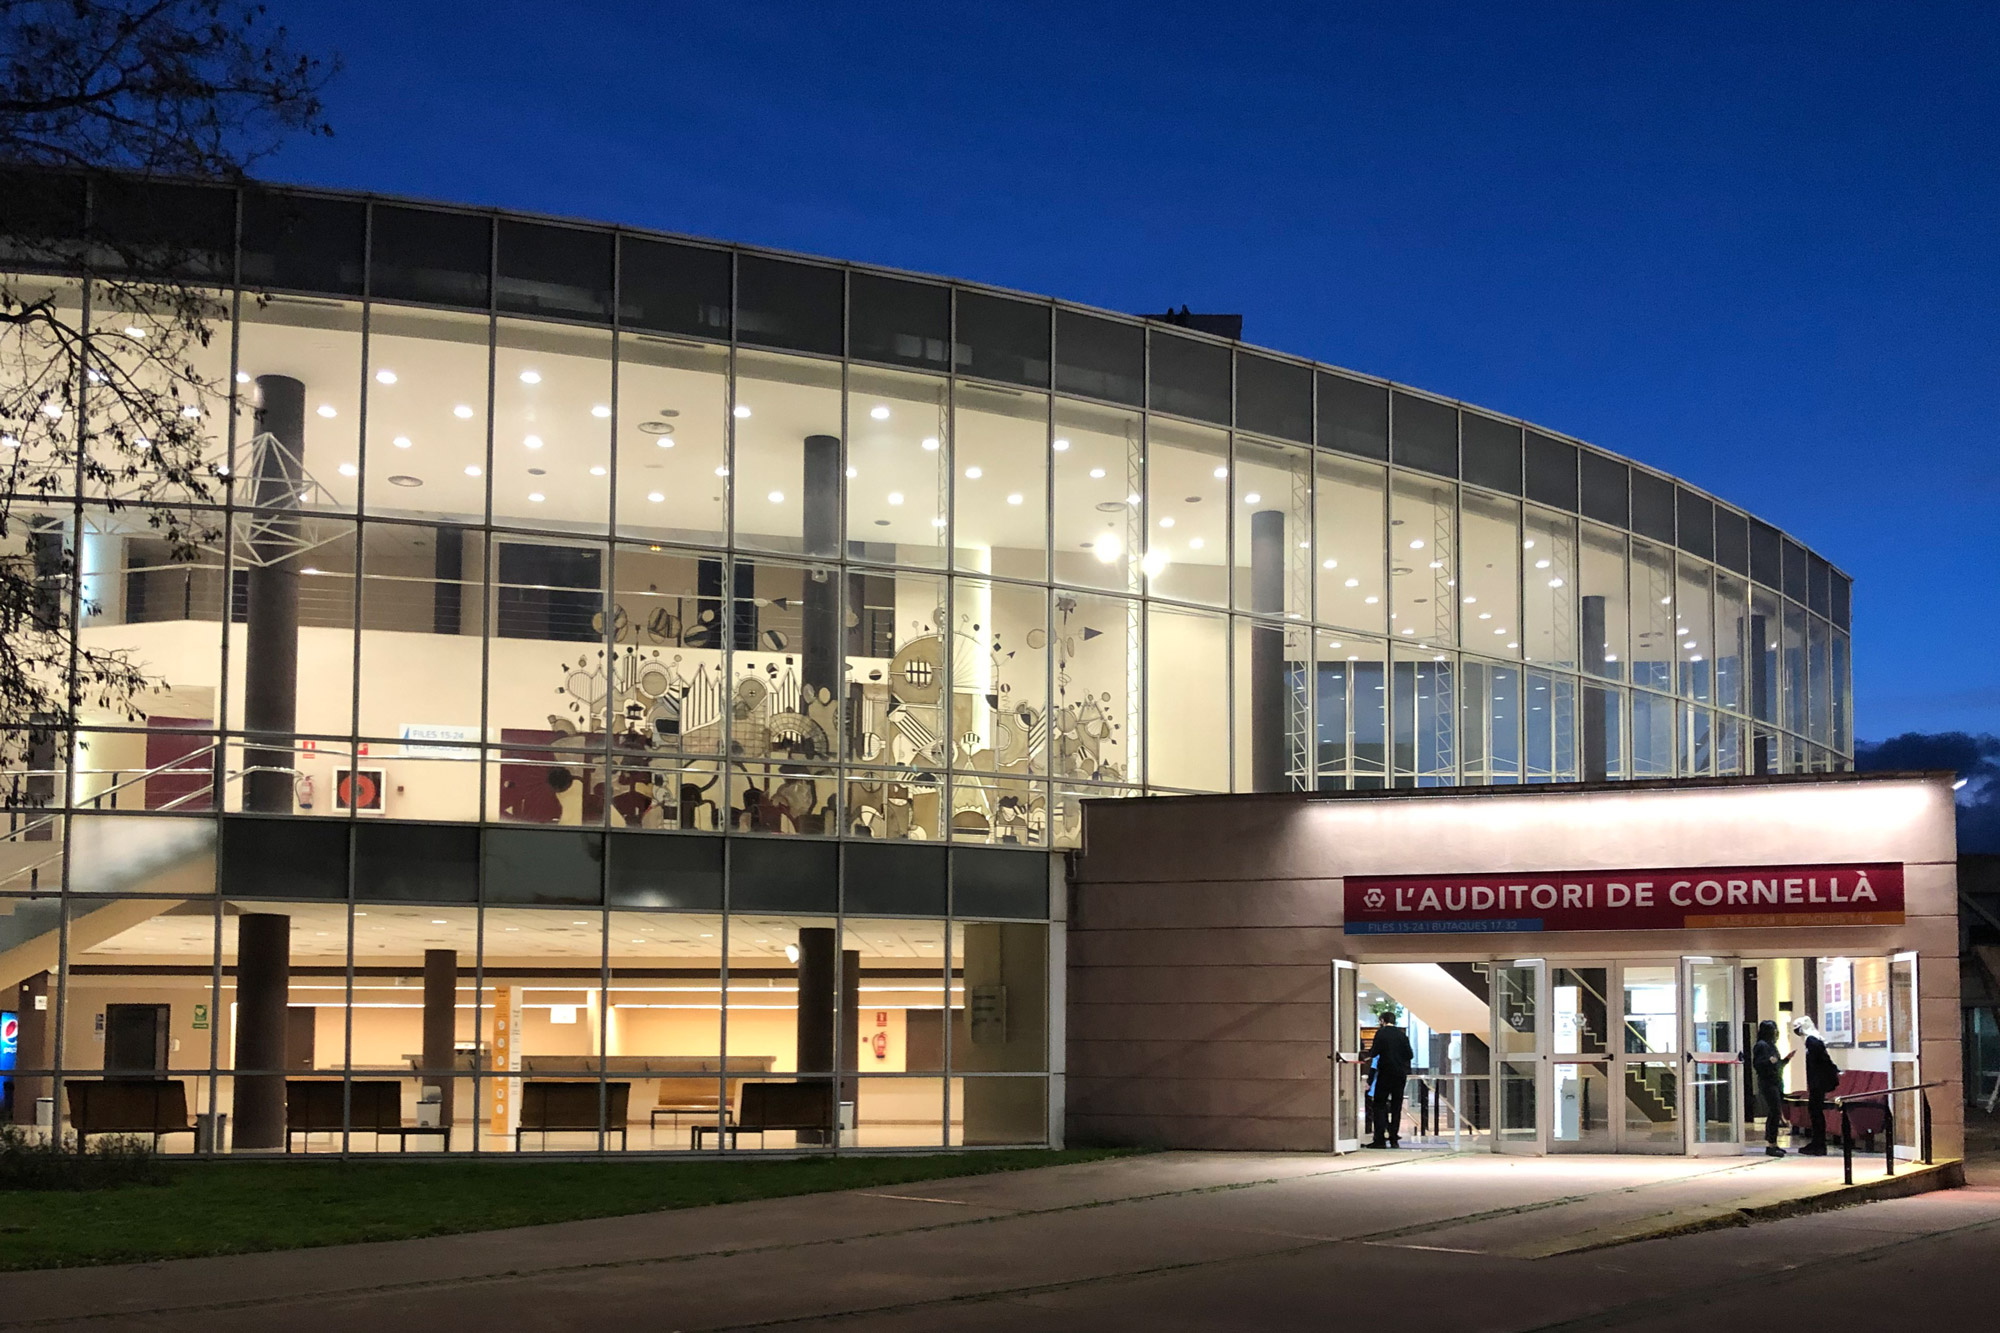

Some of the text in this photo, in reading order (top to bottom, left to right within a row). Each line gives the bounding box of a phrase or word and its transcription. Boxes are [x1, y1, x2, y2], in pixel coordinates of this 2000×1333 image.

[1607, 882, 1654, 908] DE
[1669, 870, 1878, 906] CORNELLÀ
[1368, 923, 1395, 932] FILES
[1399, 922, 1424, 931] 15-24
[1432, 921, 1487, 931] BUTAQUES
